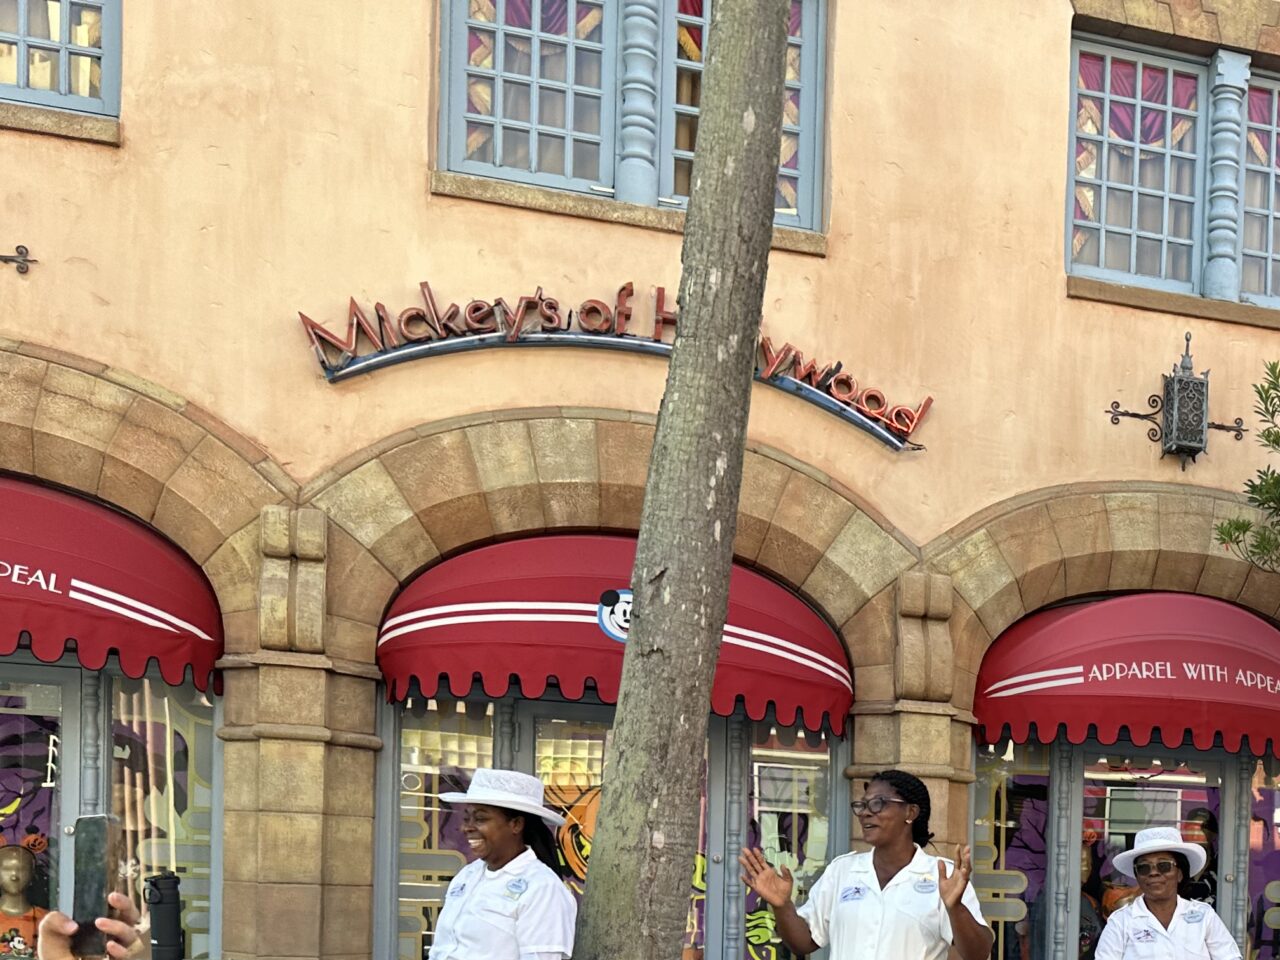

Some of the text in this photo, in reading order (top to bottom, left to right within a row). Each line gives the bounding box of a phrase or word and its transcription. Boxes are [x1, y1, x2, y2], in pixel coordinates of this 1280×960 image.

[298, 281, 935, 437] Mickey's of Hywood
[1088, 661, 1177, 682] APPAREL
[1182, 662, 1228, 684] WITH
